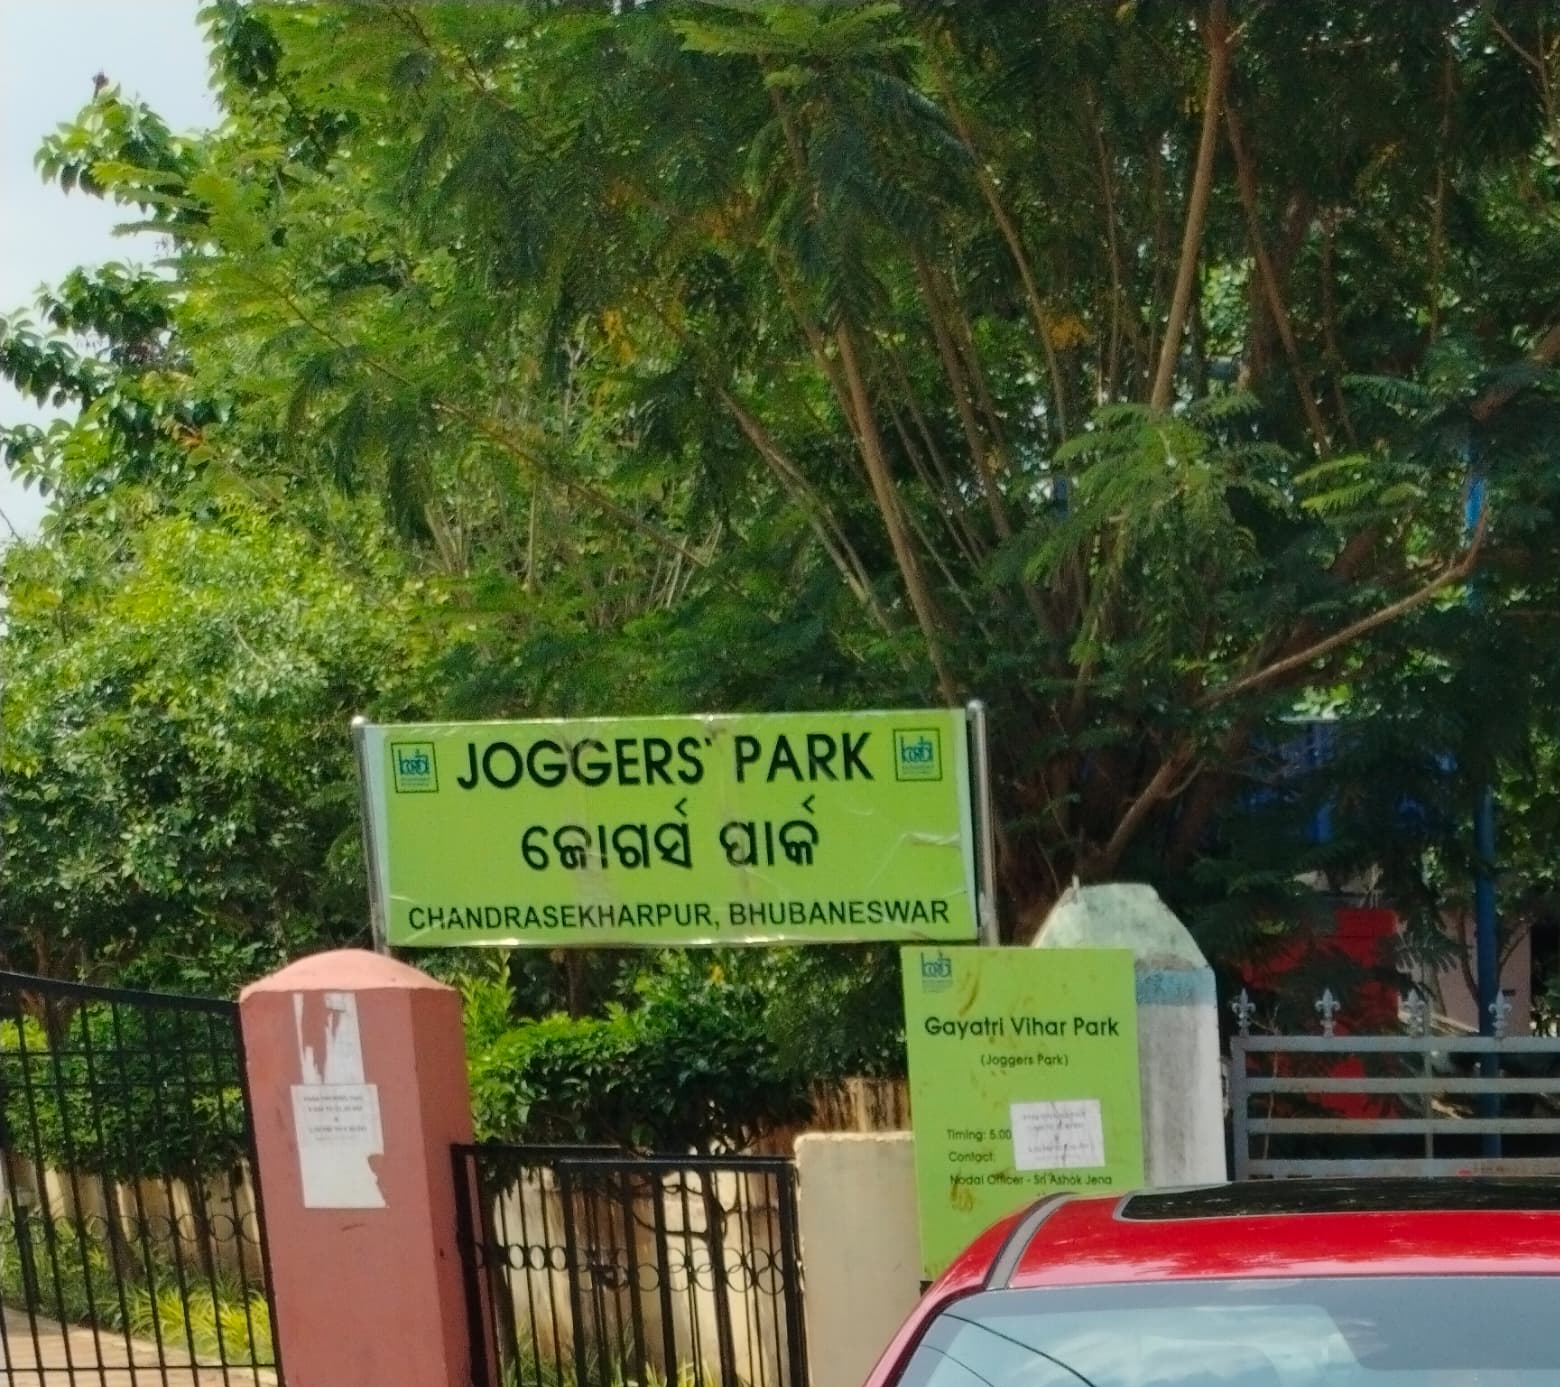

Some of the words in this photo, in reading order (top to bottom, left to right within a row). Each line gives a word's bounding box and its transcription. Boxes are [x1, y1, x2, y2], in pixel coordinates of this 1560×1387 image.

[457, 736, 713, 790] JOGGERS'
[734, 731, 874, 784] PARK
[719, 794, 819, 867] ପାର୍କ
[408, 902, 720, 931] CHANDRASEKHARPUR,
[729, 900, 950, 927] BHUBANESWAR
[924, 1016, 1004, 1040] Gayatri
[1010, 1016, 1067, 1036] Vihar
[1073, 1016, 1120, 1036] Park
[980, 1053, 1034, 1068] (Joggers
[1037, 1053, 1069, 1067] Park)
